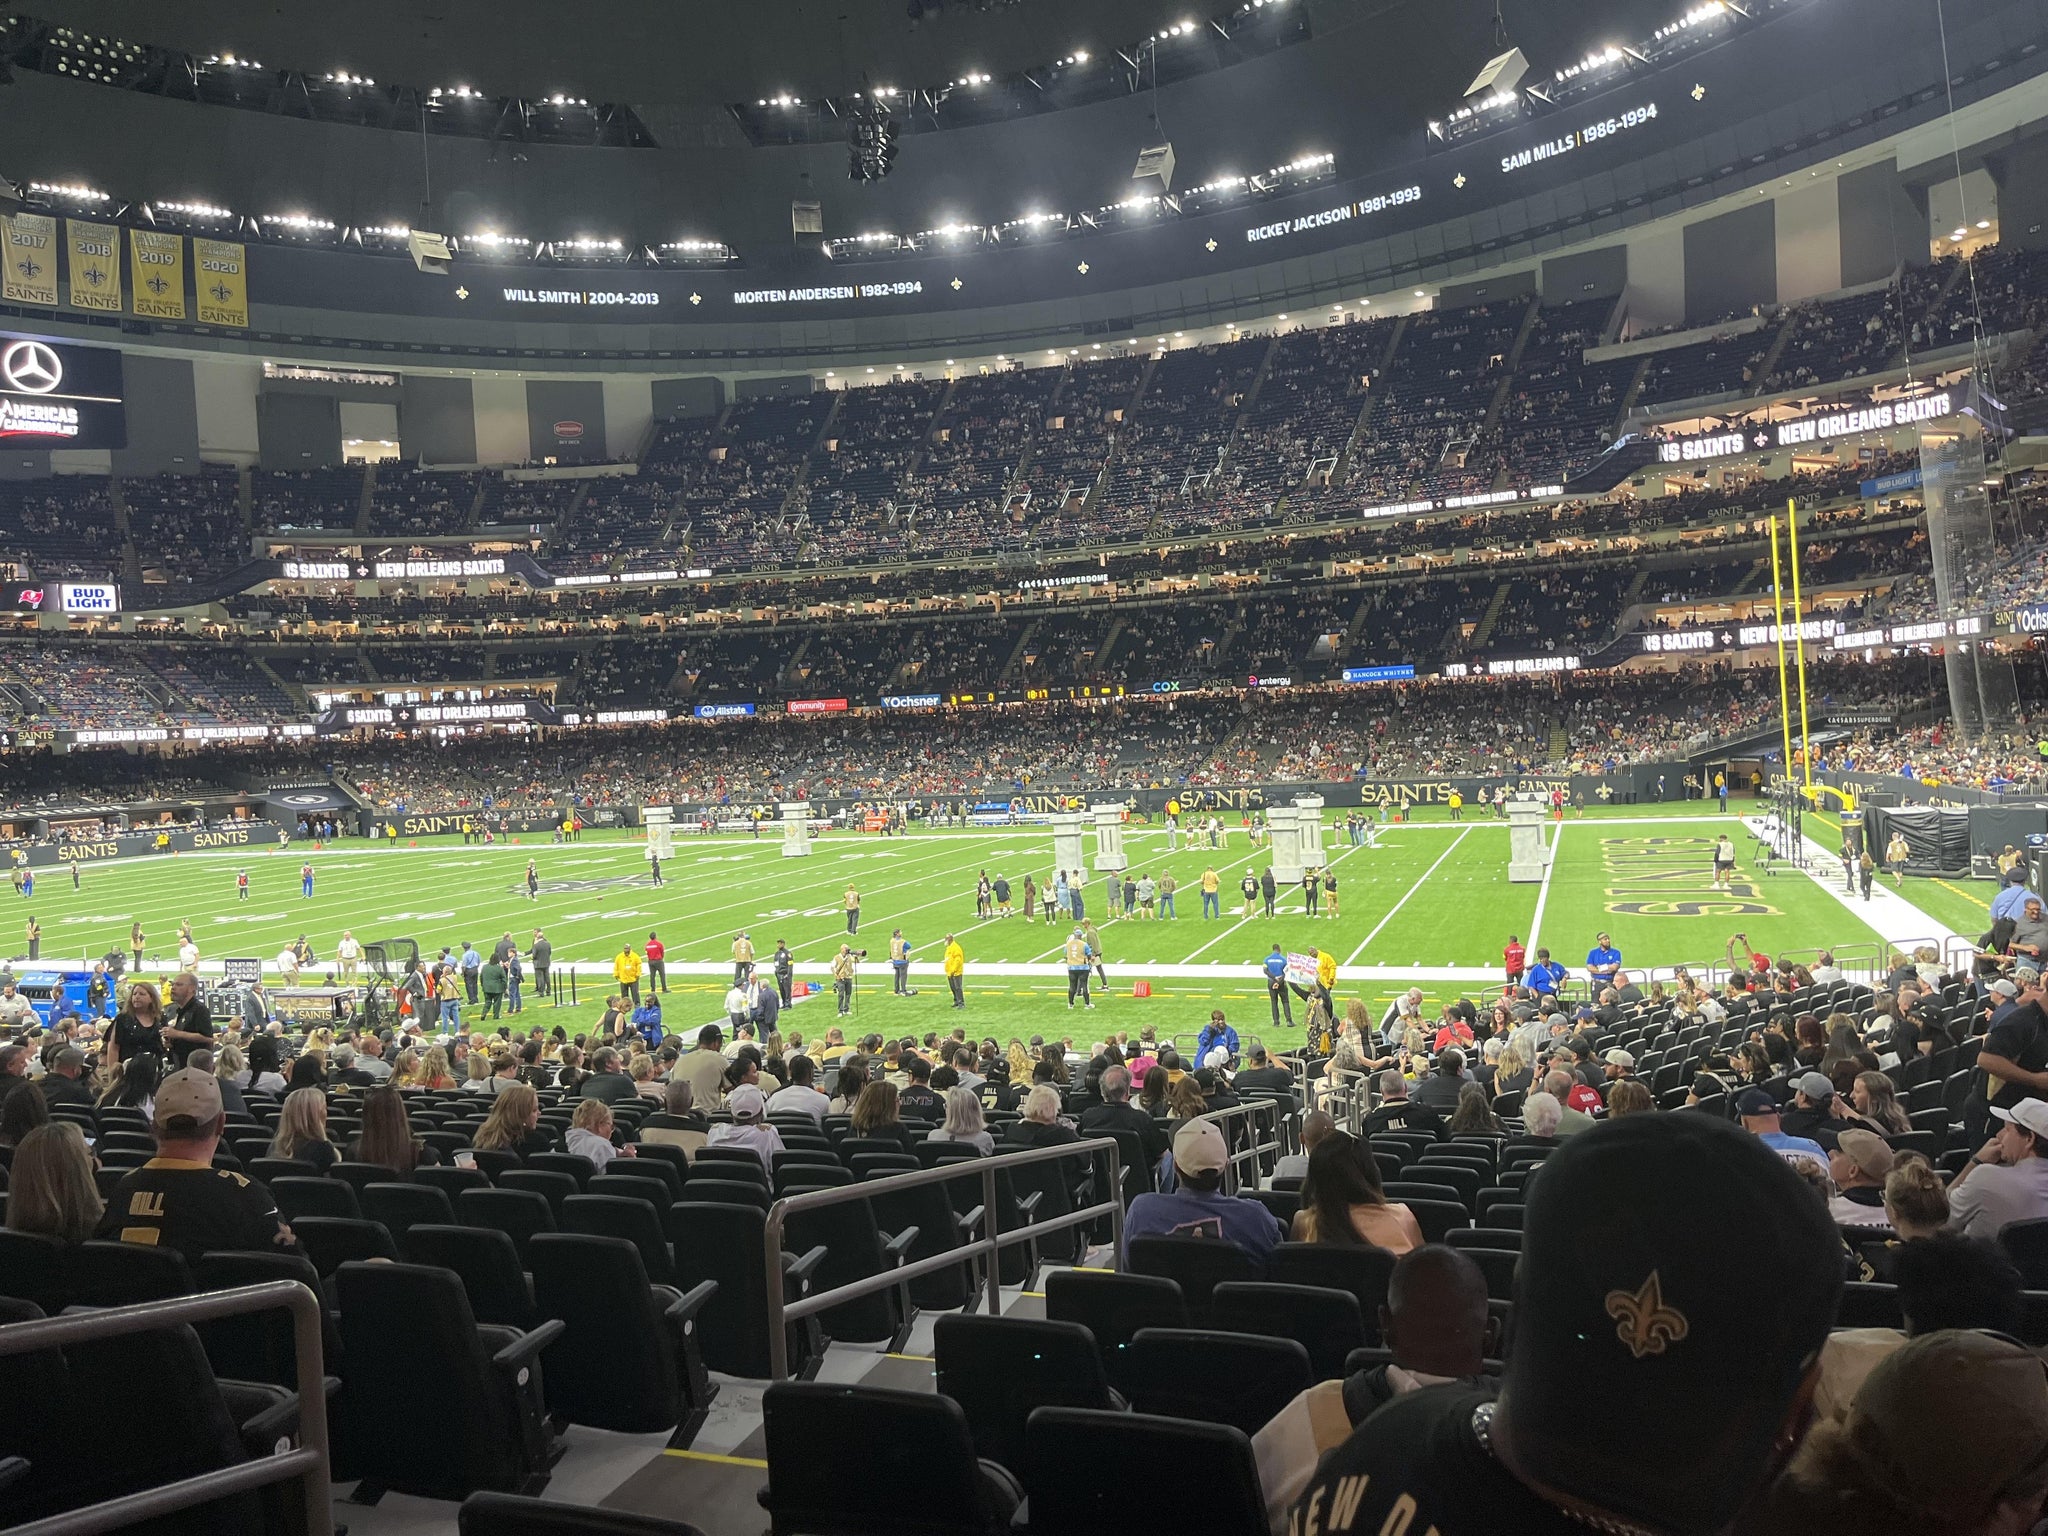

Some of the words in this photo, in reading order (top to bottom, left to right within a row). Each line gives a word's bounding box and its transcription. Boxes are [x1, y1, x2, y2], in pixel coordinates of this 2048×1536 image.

[1501, 150, 1532, 173] SAM
[1533, 134, 1575, 161] MILLS
[1582, 103, 1658, 143] 1986-1994
[1247, 220, 1291, 242] RICKEY
[1292, 206, 1351, 232] JACKSON
[1358, 186, 1421, 215] 1981-1993
[11, 232, 48, 249] 2017
[77, 241, 112, 257] 2018
[140, 251, 175, 266] 2019
[202, 259, 239, 274] 2020
[6, 286, 54, 303] SAINTS
[503, 288, 537, 302] WILL
[538, 290, 581, 304] SMITH
[589, 292, 660, 305] 2004-2013
[734, 289, 786, 304] MORTEN
[788, 286, 854, 301] ANDERSEN
[860, 280, 923, 297] 1982-1994
[74, 295, 119, 309] SAINTS
[136, 303, 182, 317] SAINTS
[201, 310, 245, 325] SAINTS
[1, 399, 79, 424] AMERICAS
[1778, 421, 1817, 445] NEW
[1818, 408, 1893, 438] ORLEANS
[1895, 393, 1950, 424] SAINTS
[1682, 433, 1744, 459] SAINTS
[1892, 476, 1911, 487] LIGHT
[1548, 485, 1563, 495] ORL
[1707, 505, 1743, 518] SAINTS
[1283, 515, 1316, 525] SAINTS
[1628, 516, 1664, 528] SAINTS
[1211, 522, 1243, 533] SAINTS
[1550, 527, 1585, 538] SAINTS
[1473, 535, 1507, 545] SAINTS
[300, 563, 349, 578] SAINTS
[376, 563, 405, 578] NEW
[406, 561, 462, 577] ORLEANS
[463, 559, 505, 575] SAINTS
[1061, 574, 1109, 584] SUPERDOME
[73, 588, 105, 598] BUD
[67, 598, 112, 608] LIGHT
[1662, 631, 1714, 650] SAINTS
[1740, 626, 1768, 645] NEW
[1489, 661, 1514, 674] NEW
[1515, 658, 1564, 673] ORLEANS
[1353, 671, 1382, 679] HANCOCK
[1383, 669, 1414, 677] WHITNEY
[1152, 681, 1180, 693] COX
[1201, 678, 1233, 688] SAINTS
[1258, 676, 1291, 686] entergy
[890, 695, 939, 708] Ochsner
[988, 692, 994, 702] 0
[416, 708, 441, 721] NEW
[442, 705, 490, 719] ORLEANS
[492, 704, 526, 717] SAINTS
[715, 706, 747, 716] Allstate
[790, 701, 827, 712] Community
[355, 709, 393, 722] SAINTS
[597, 712, 617, 723] NEW
[618, 711, 656, 722] ORLEANS
[18, 731, 54, 740] SAINTS
[77, 732, 97, 742] NEW
[98, 730, 134, 741] ORLEANS
[136, 729, 168, 741] SAINTS
[184, 729, 202, 739] NEW
[203, 727, 238, 738] ORLEANS
[239, 726, 268, 737] SAINTS
[283, 725, 300, 735] NEW
[301, 725, 315, 735] ORL
[1361, 782, 1451, 803] SAINTS
[0, 805, 129, 819] PERDOME
[404, 813, 475, 835] SAINTS
[194, 830, 248, 848] SAINTS
[58, 841, 118, 860] SAINTS
[299, 1010, 332, 1020] SAINTS
[981, 1096, 998, 1110] 7
[1387, 1117, 1408, 1130] HILL
